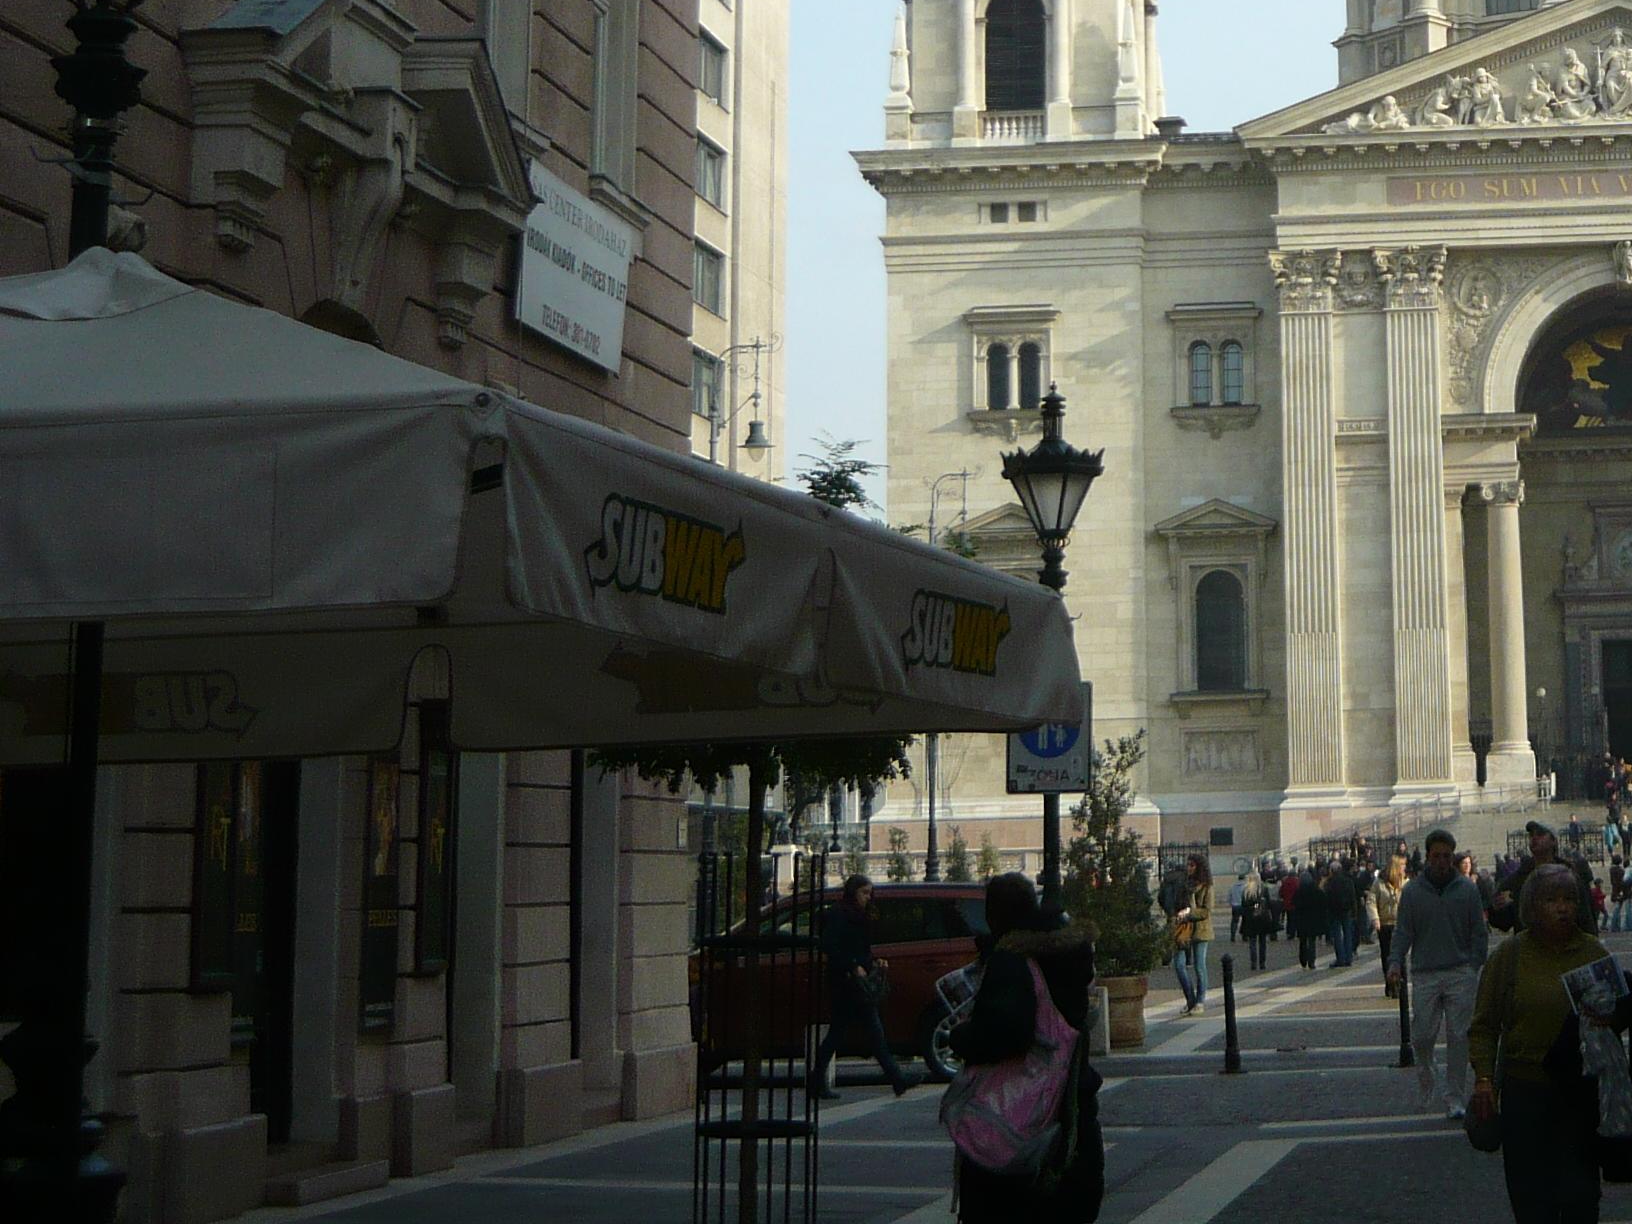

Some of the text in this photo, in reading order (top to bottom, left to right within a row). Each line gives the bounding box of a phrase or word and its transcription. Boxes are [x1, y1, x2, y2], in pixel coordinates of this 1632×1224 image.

[1415, 180, 1466, 201] EGO
[1483, 176, 1538, 198] SUM
[1557, 174, 1602, 195] VIA
[580, 261, 606, 293] OFFICES
[607, 276, 616, 298] TO
[615, 282, 627, 303] LET
[583, 492, 746, 614] SUBWAY
[900, 586, 1011, 677] SUBWAY
